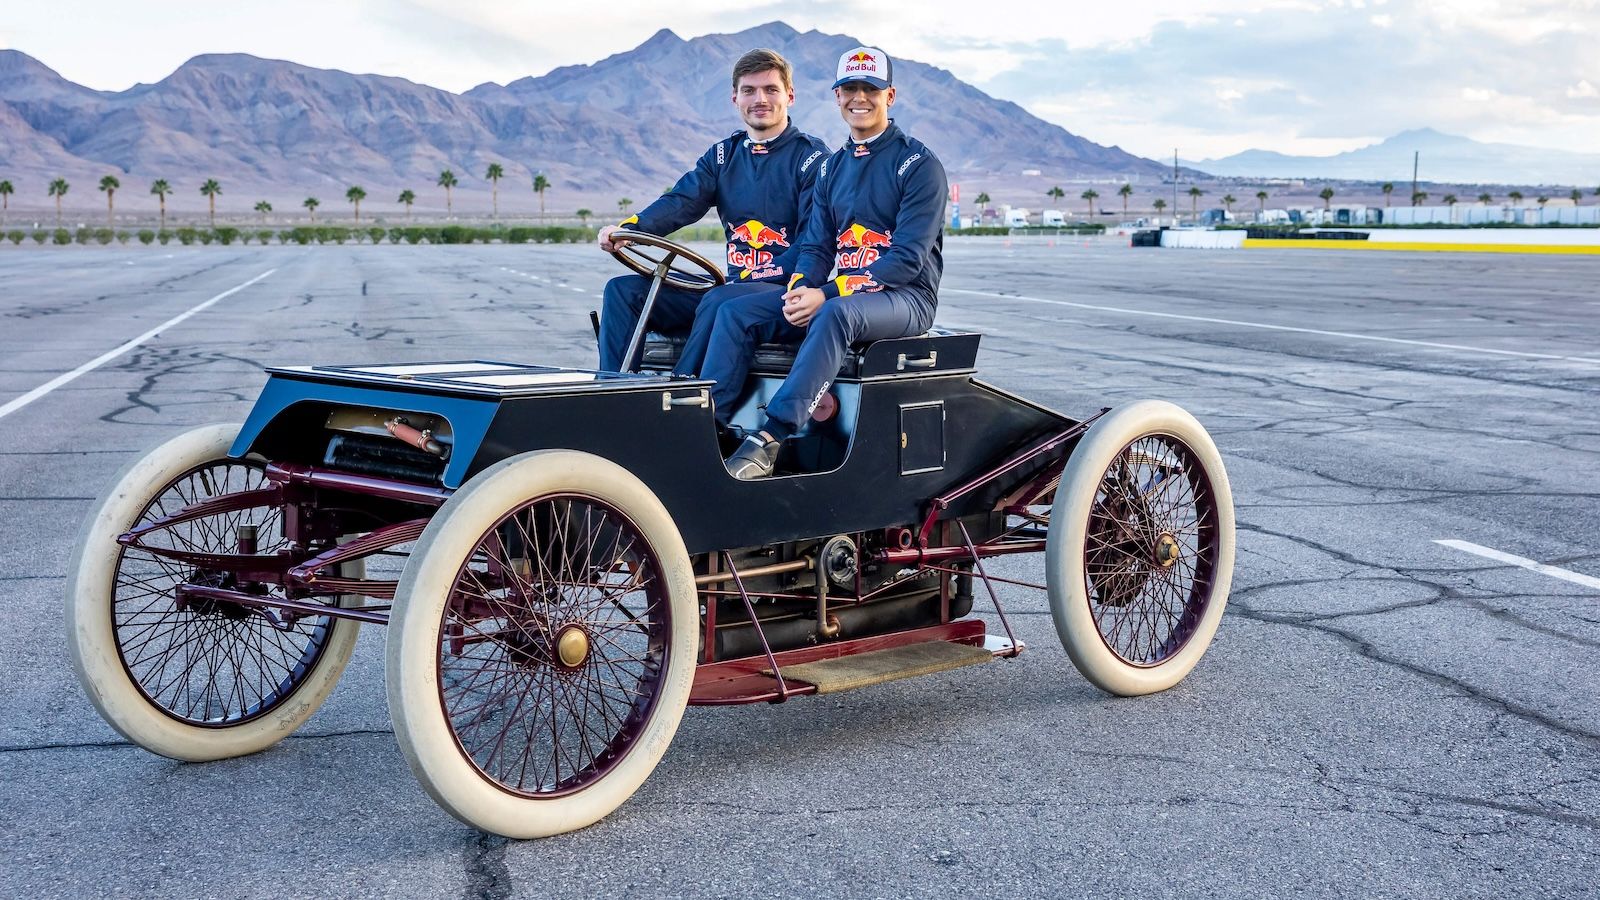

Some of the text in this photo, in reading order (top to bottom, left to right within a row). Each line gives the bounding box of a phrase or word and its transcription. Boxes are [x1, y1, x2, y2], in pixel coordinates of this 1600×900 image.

[846, 63, 876, 72] Red Bull
[801, 150, 822, 172] sparco
[898, 153, 921, 176] sparco
[728, 243, 756, 269] Red
[808, 381, 830, 414] sparco
